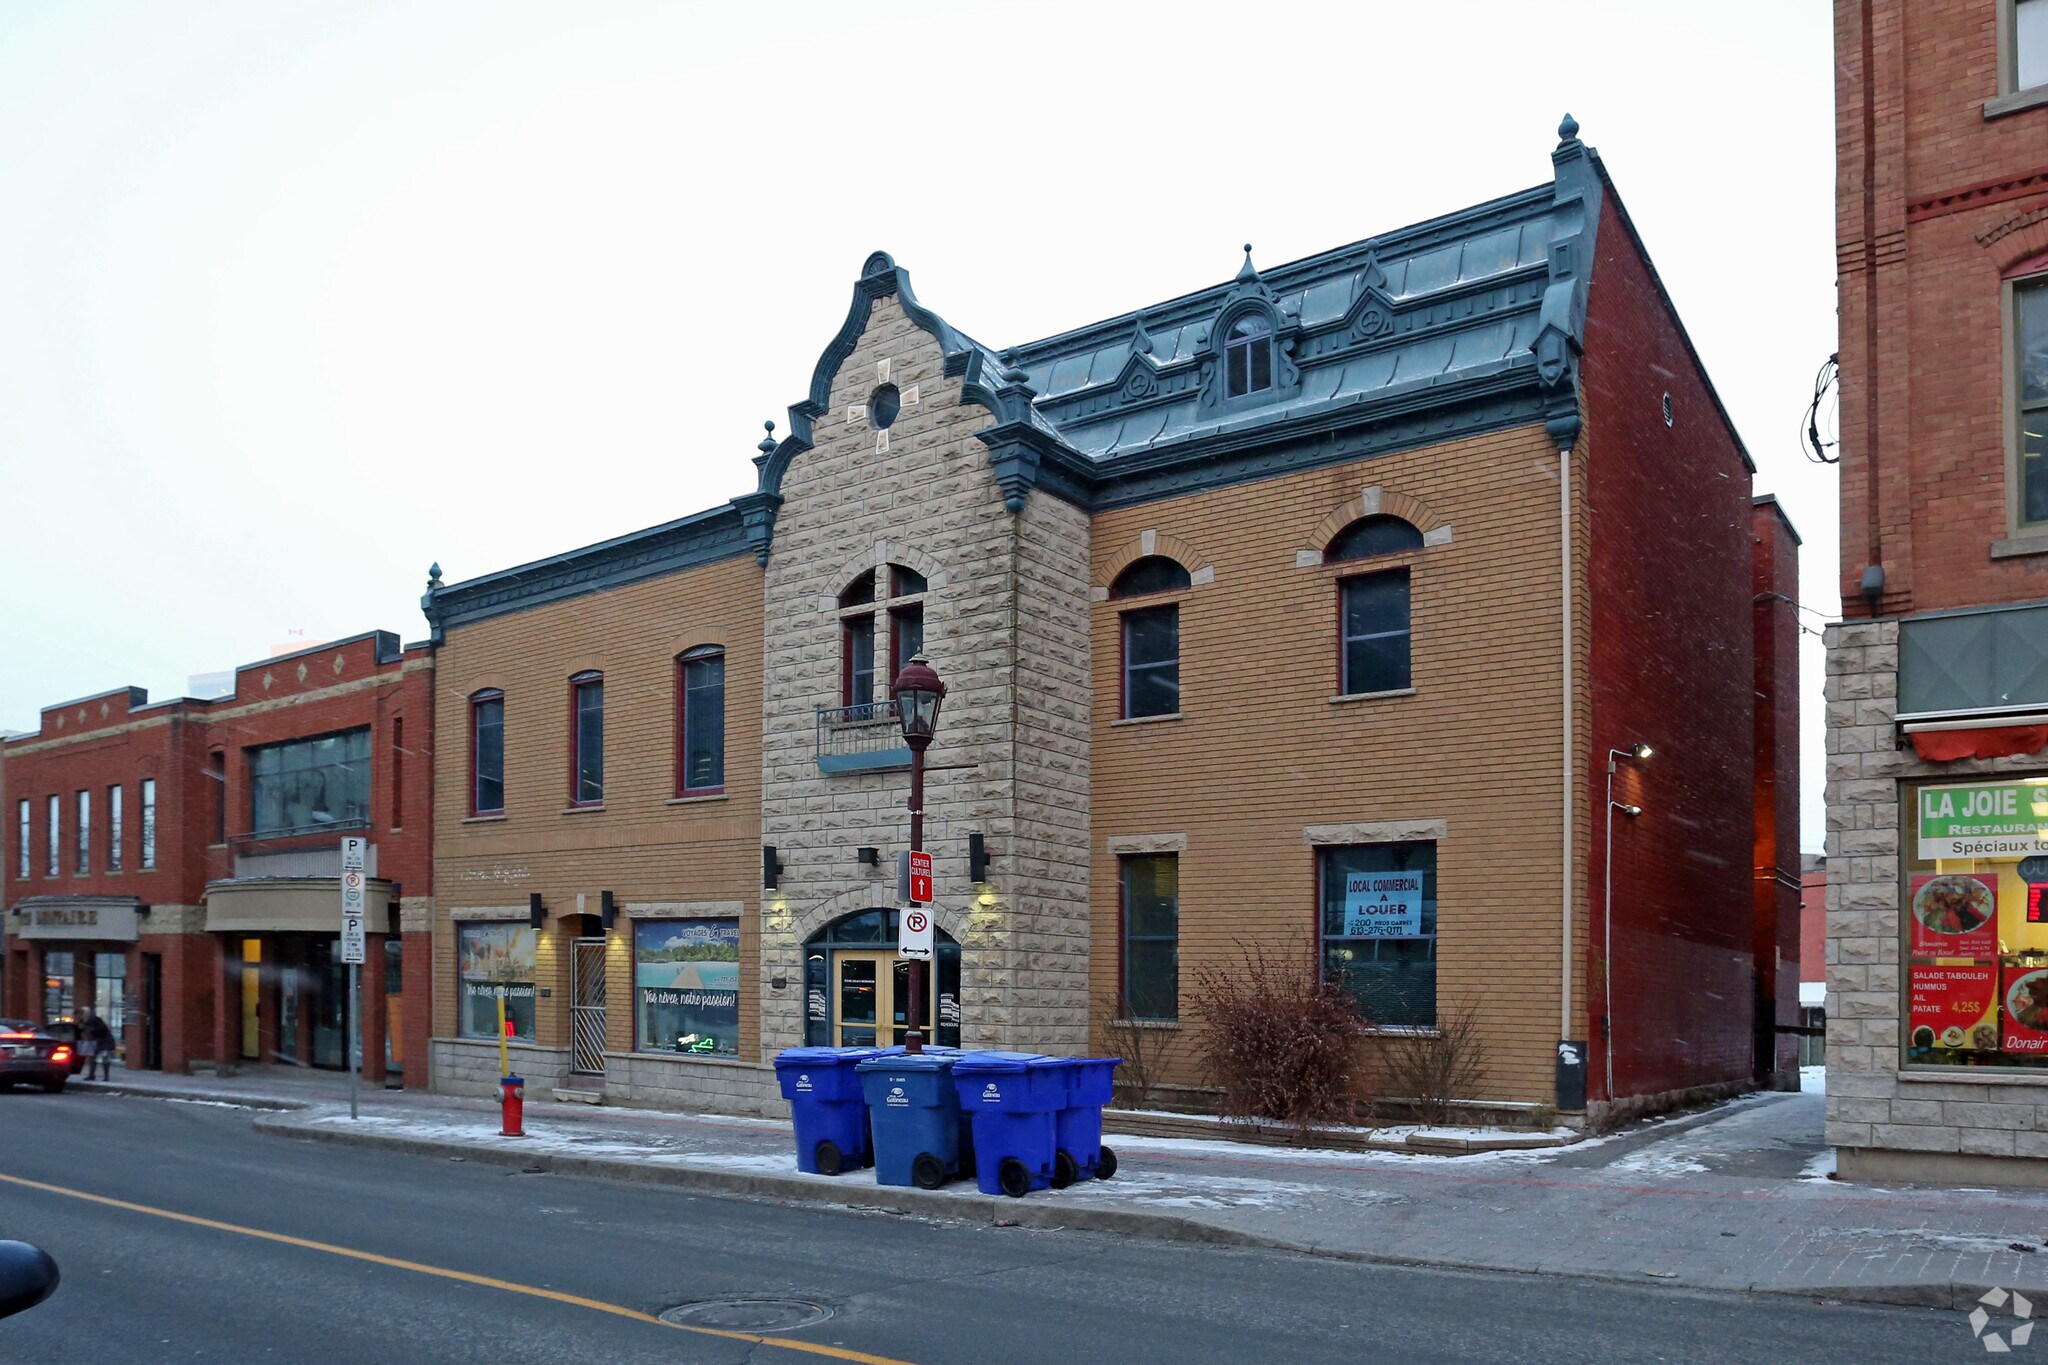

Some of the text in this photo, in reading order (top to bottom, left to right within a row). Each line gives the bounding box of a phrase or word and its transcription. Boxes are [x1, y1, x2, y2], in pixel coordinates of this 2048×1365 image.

[1925, 793, 1955, 818] LA
[1961, 789, 2018, 817] JOIE
[1952, 843, 2029, 855] Spéciaux
[912, 857, 930, 868] SENTIER
[911, 866, 933, 878] CULTUREL
[1349, 879, 1419, 892] LOCAL COMMERCIAL
[1358, 905, 1407, 915] LOUER
[1947, 972, 1989, 980] TABOULEH
[644, 989, 658, 1004] Vos
[680, 991, 701, 1006] notre
[701, 993, 736, 1011] passion!
[1913, 1005, 1941, 1013] PATATE
[1951, 1001, 1981, 1014] 4,25$
[2006, 1035, 2048, 1049] Donair
